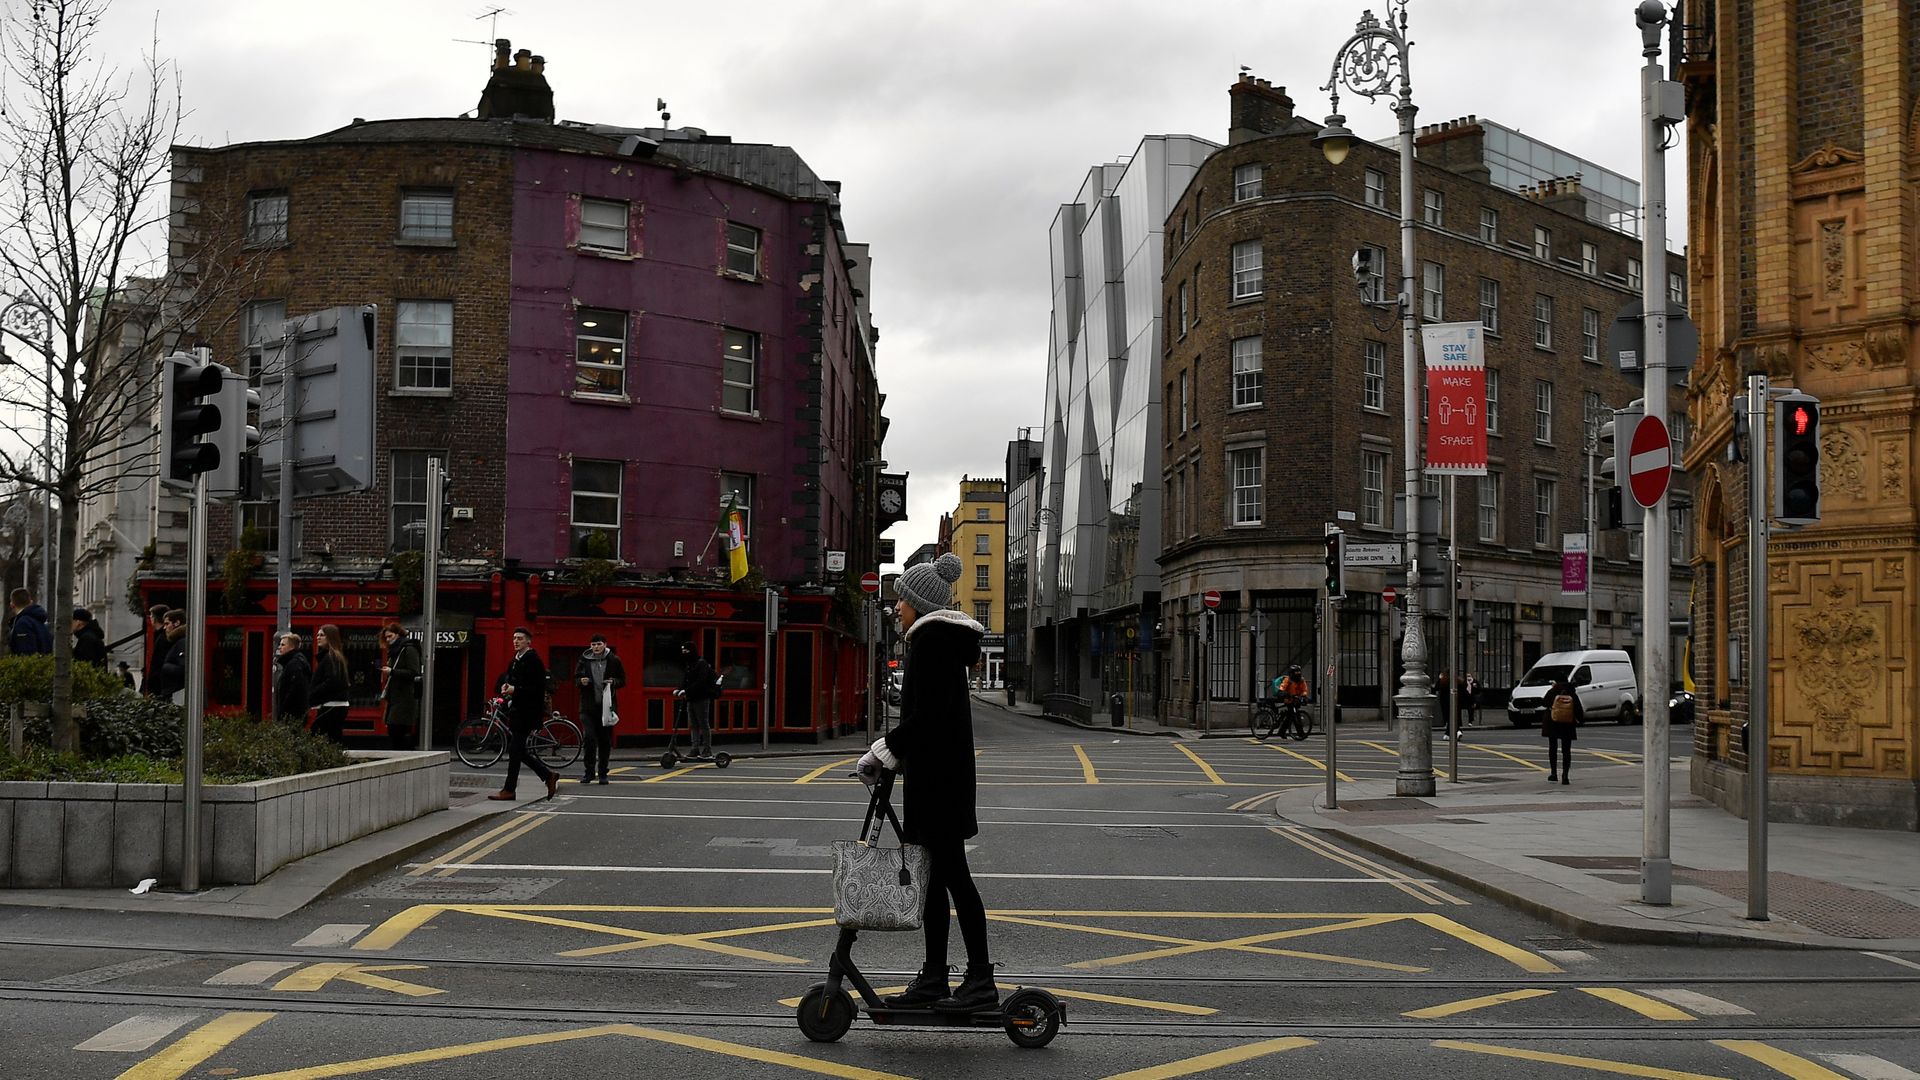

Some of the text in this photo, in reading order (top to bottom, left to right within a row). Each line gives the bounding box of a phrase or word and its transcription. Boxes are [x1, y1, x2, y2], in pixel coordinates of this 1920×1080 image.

[1442, 344, 1467, 352] STAY
[1443, 353, 1468, 361] SAFE
[1442, 377, 1472, 387] MAKE
[1440, 435, 1474, 446] SPACE
[623, 598, 717, 616] DOYLES
